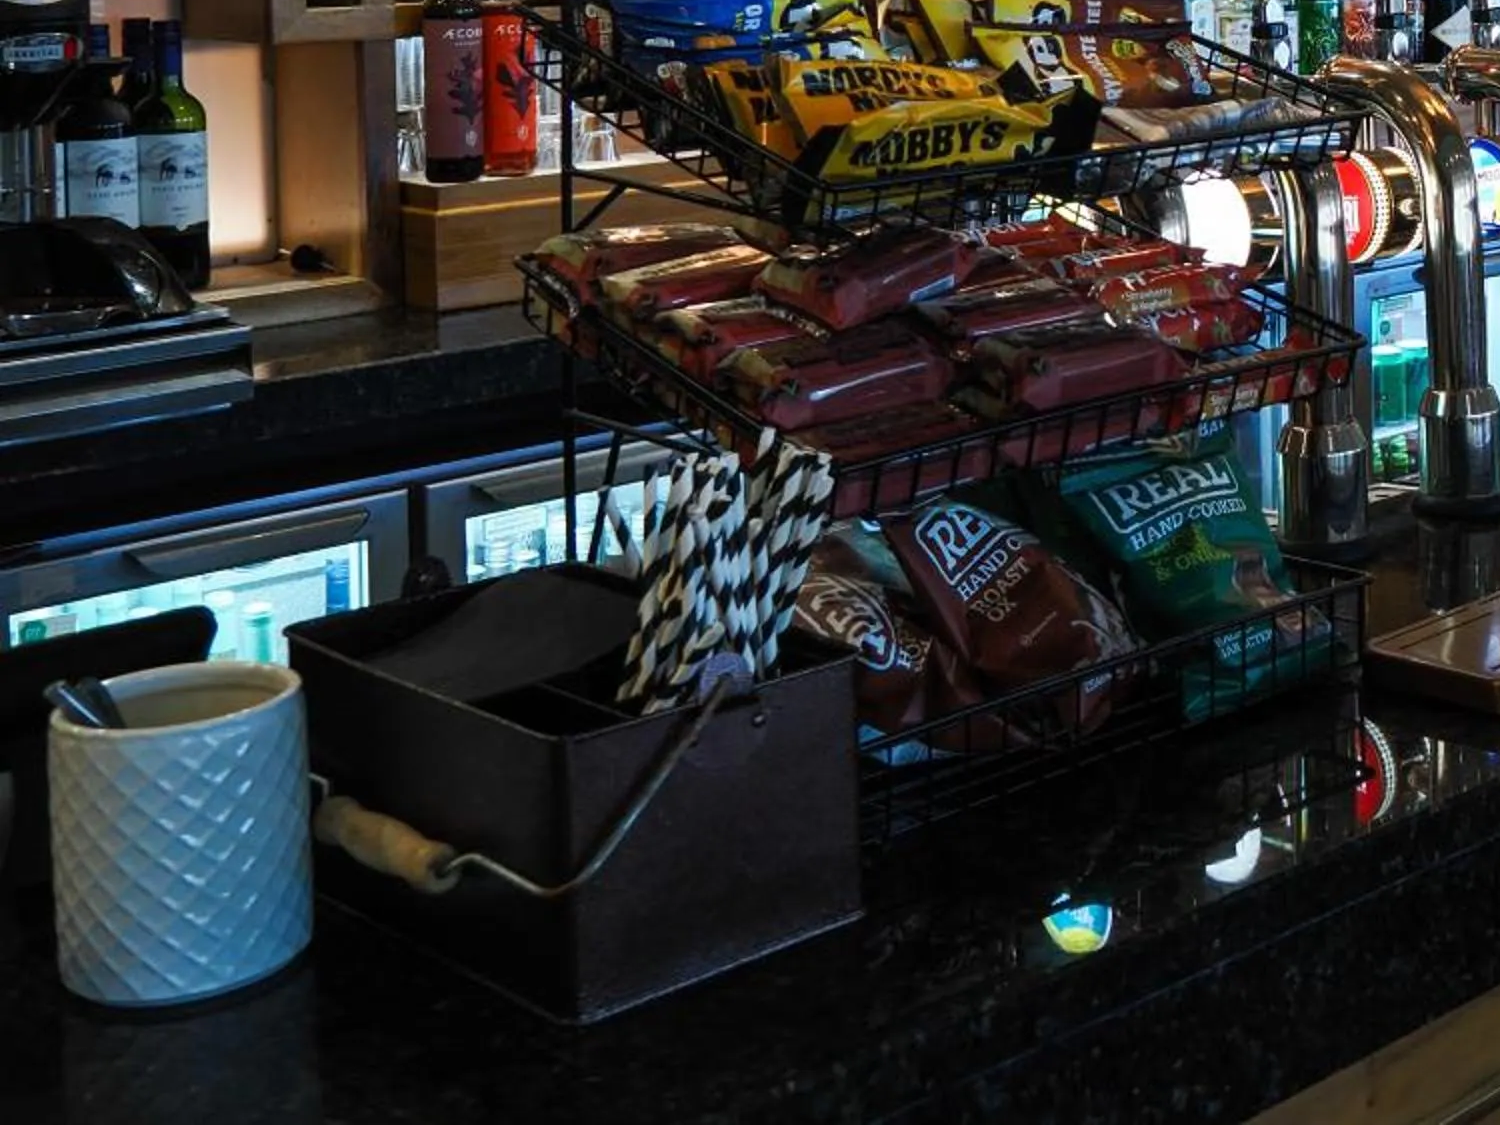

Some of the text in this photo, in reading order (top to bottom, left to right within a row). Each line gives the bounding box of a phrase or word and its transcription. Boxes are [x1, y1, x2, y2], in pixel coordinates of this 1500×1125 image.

[849, 116, 1009, 167] NOBBY'S
[1104, 462, 1231, 521] REAL
[1130, 511, 1184, 552] HAND
[1187, 497, 1248, 520] COOKED
[957, 549, 1009, 602] HAND
[969, 556, 1032, 616] ROAST
[985, 598, 1018, 623] OX
